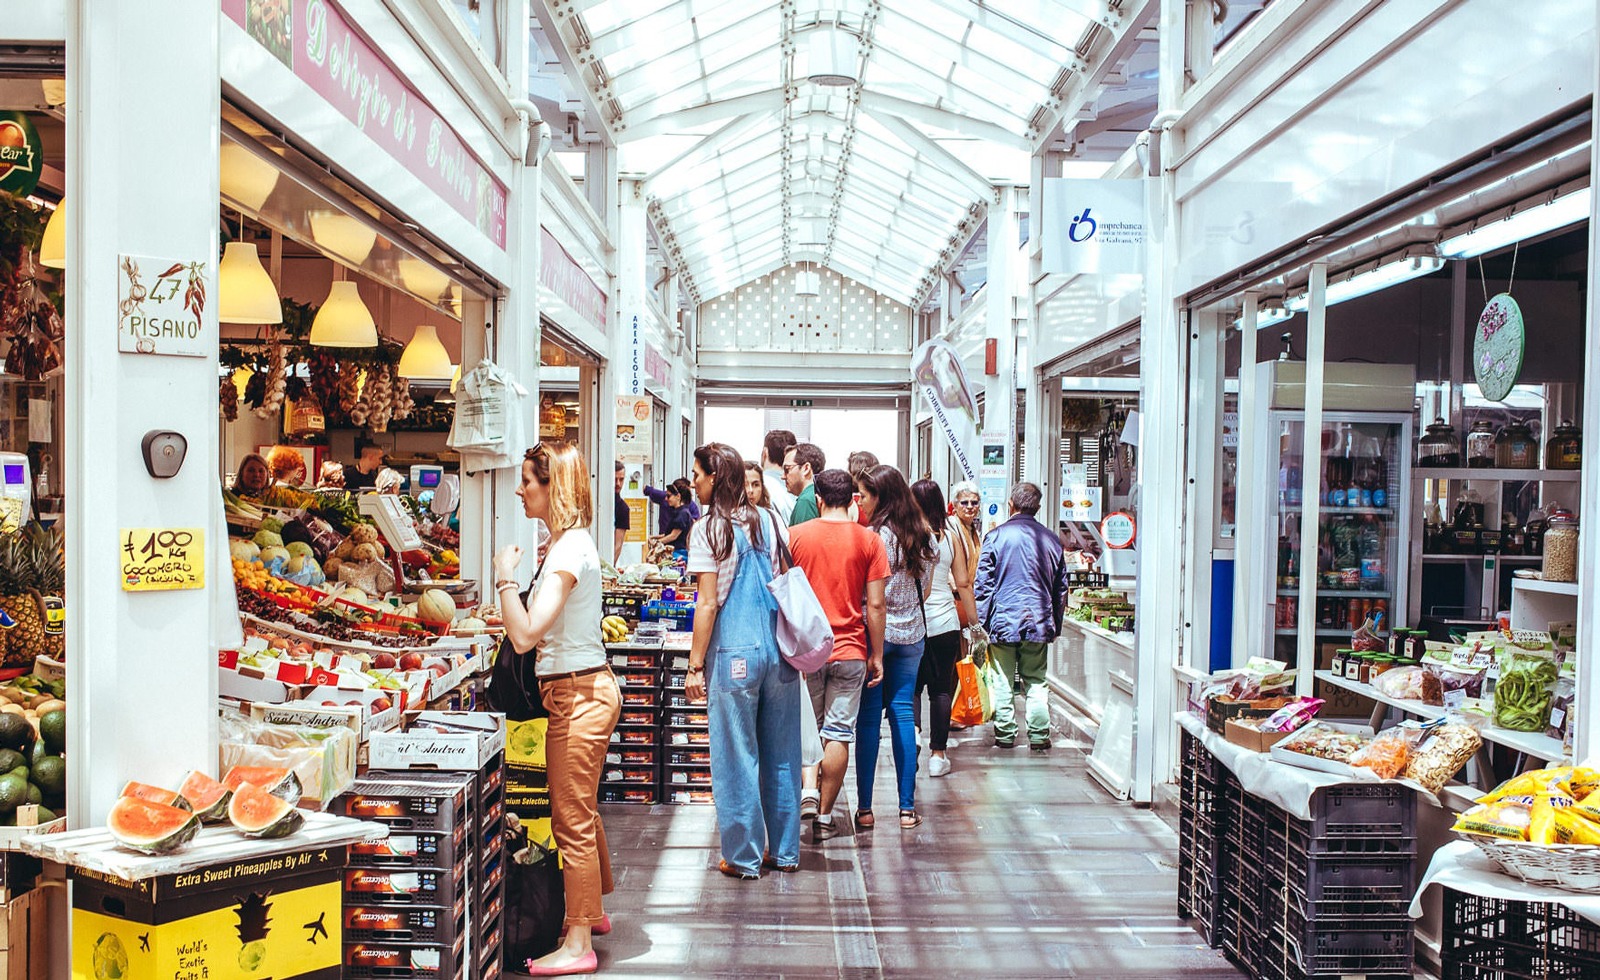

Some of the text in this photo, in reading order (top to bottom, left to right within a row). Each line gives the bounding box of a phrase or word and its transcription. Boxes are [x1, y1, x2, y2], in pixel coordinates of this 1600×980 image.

[493, 188, 505, 220] BOX
[149, 279, 182, 304] 47
[130, 316, 197, 339] PISANO
[174, 853, 313, 888] Extra Sweet Pineapples By Air
[176, 939, 208, 956] World's
[179, 956, 205, 969] Exotic
